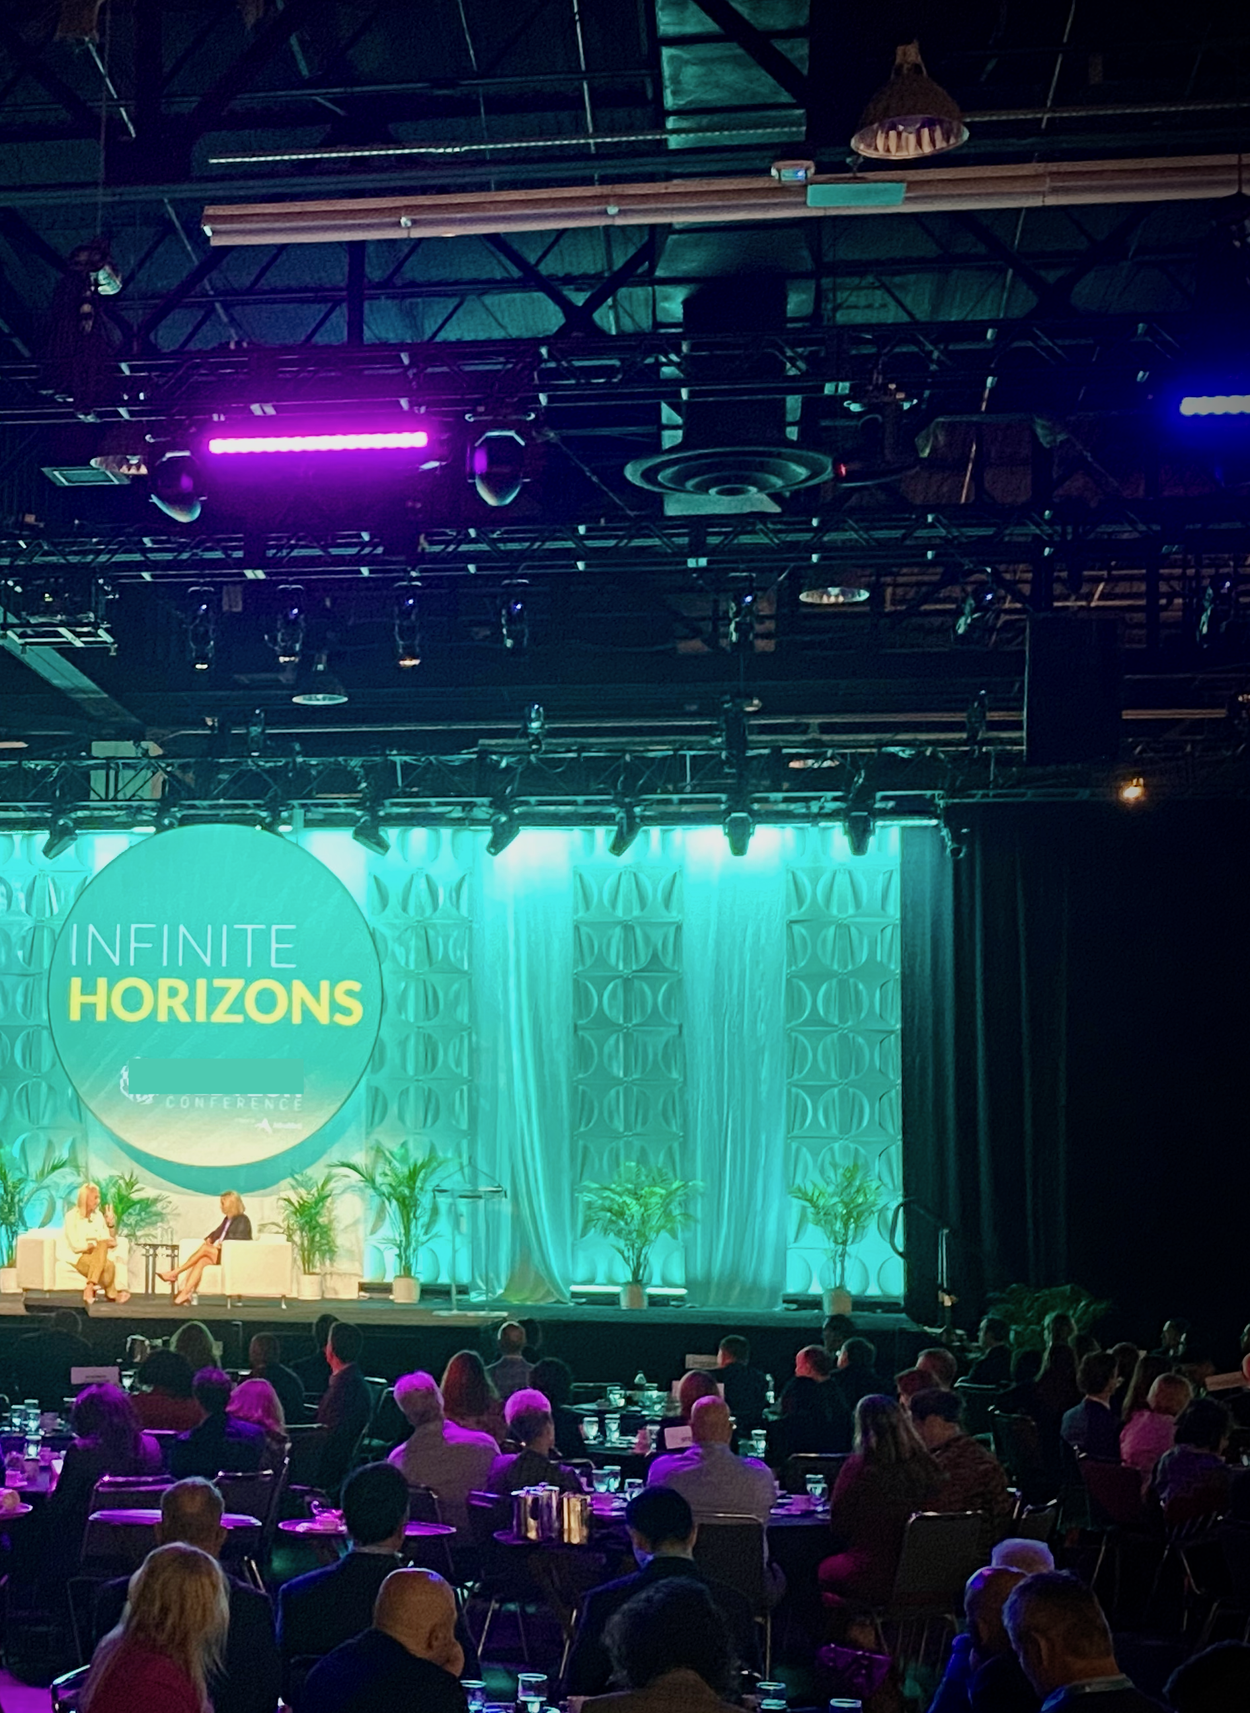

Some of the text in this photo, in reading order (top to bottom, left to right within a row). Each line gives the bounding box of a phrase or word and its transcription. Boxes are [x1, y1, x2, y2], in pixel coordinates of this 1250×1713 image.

[70, 923, 297, 968] INFINITE
[68, 977, 364, 1026] HORIZONS
[165, 1096, 303, 1112] CONFERENCE
